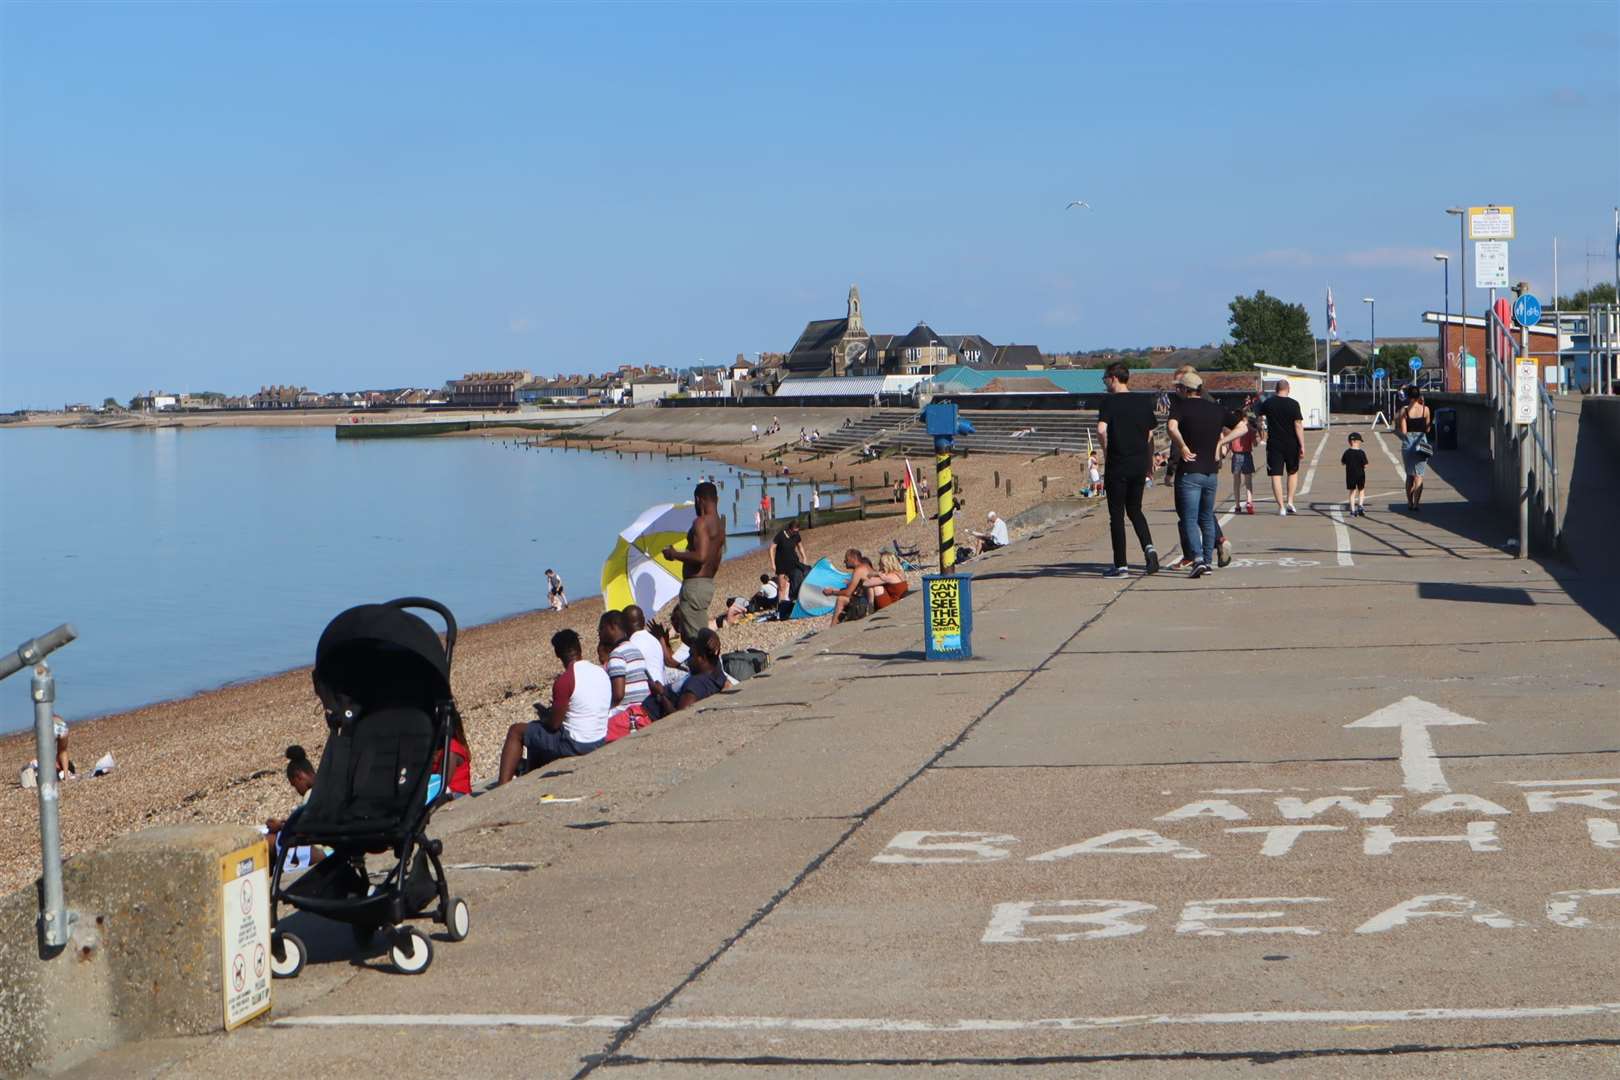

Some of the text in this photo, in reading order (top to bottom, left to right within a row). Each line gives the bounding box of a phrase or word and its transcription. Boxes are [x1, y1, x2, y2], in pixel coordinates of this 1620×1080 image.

[930, 583, 957, 591] CAN
[931, 591, 957, 599] YOU
[931, 599, 957, 609] SEE
[932, 609, 958, 618] THE
[932, 618, 958, 627] SEA
